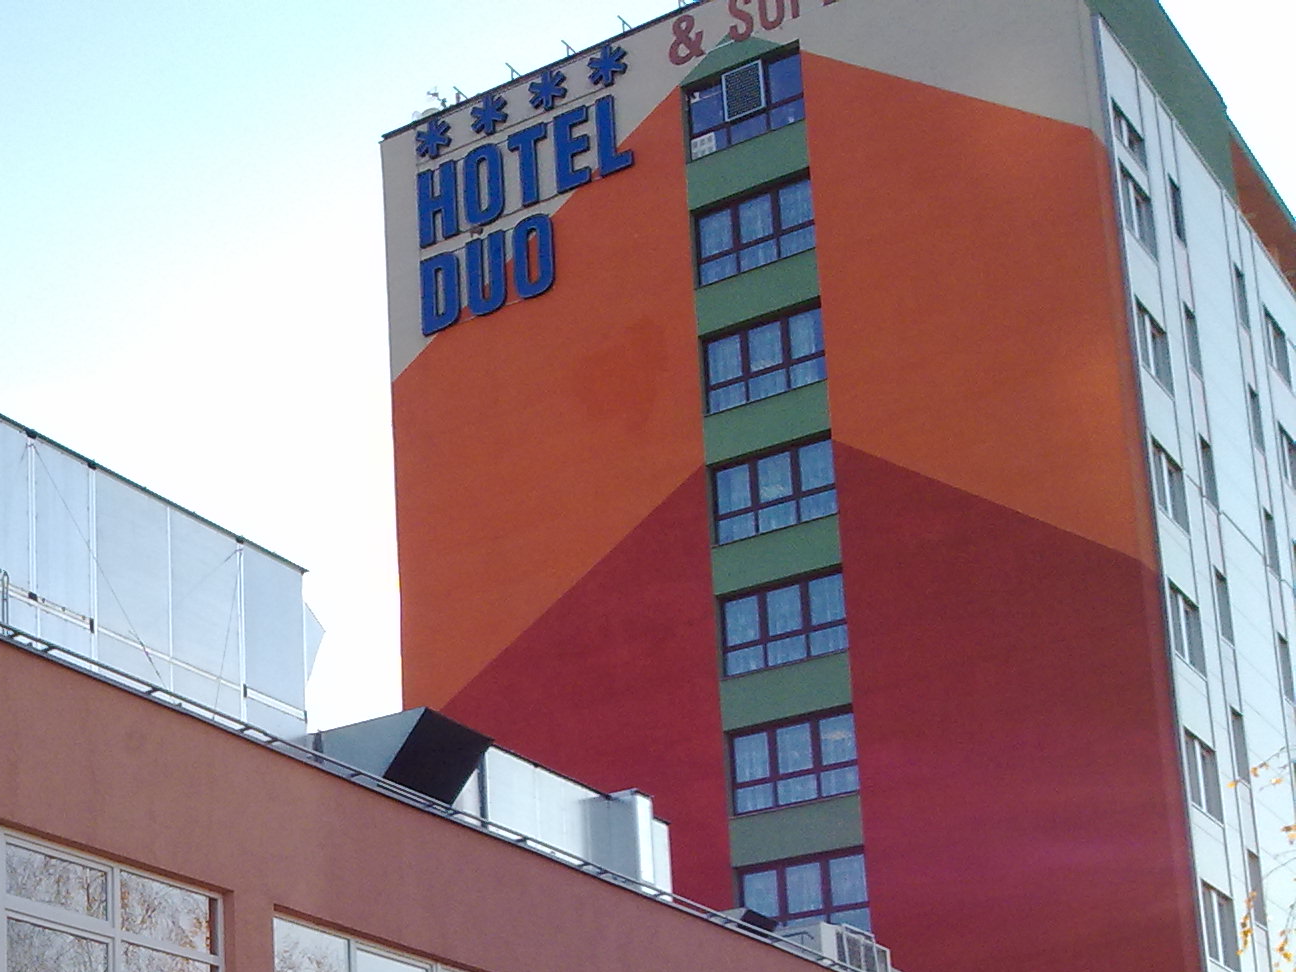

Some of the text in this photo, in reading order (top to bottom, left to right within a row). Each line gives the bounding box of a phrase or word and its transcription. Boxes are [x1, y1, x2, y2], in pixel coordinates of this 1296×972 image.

[669, 14, 706, 65] &
[417, 94, 634, 248] HOTEL
[420, 213, 555, 337] DUO
